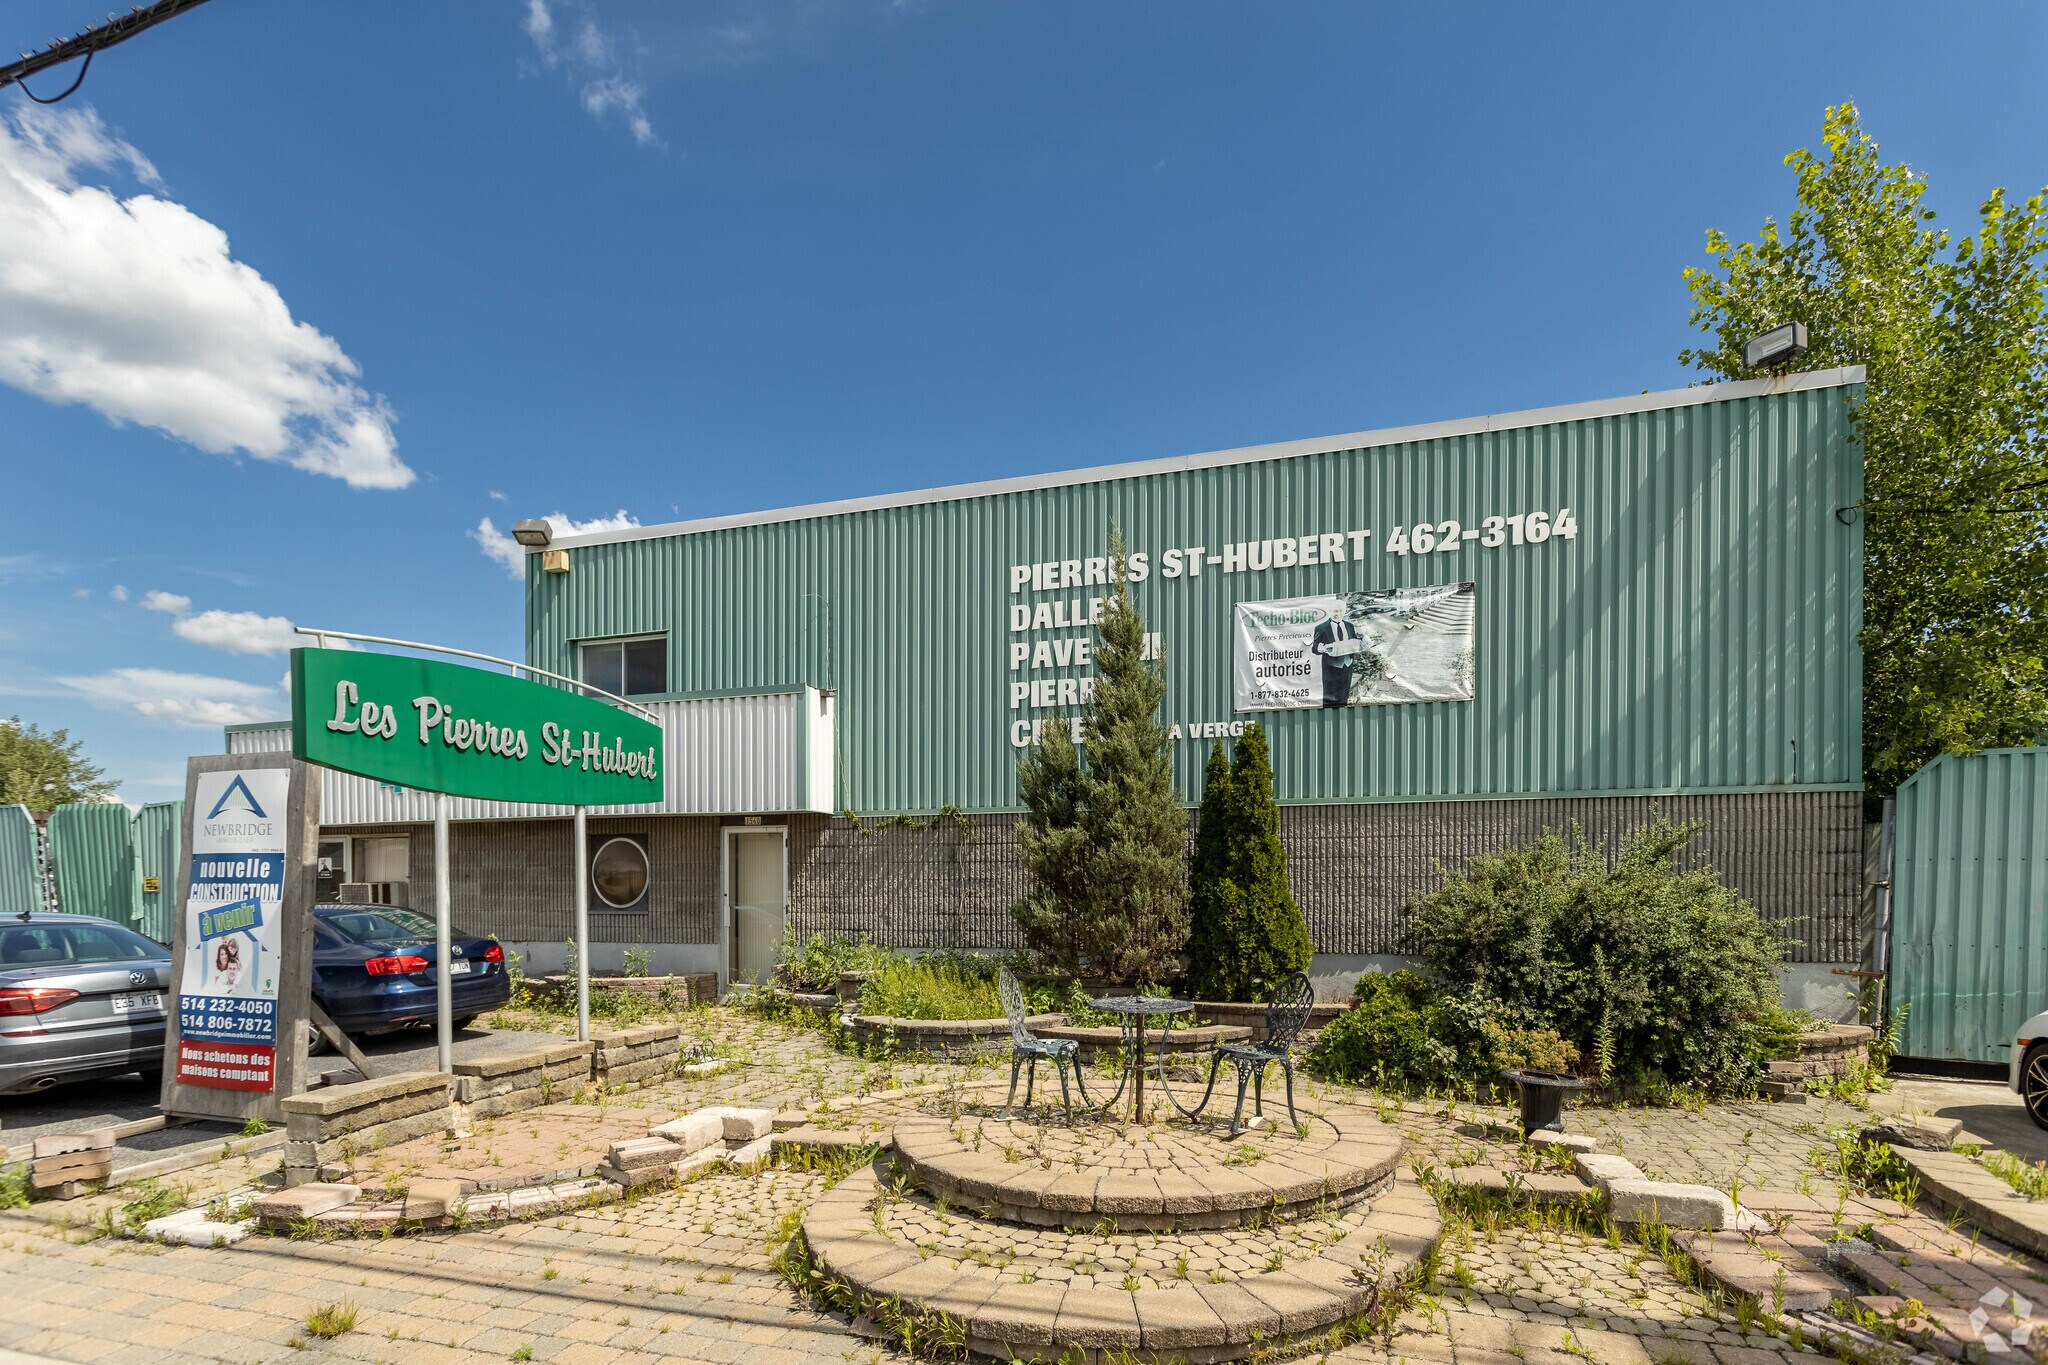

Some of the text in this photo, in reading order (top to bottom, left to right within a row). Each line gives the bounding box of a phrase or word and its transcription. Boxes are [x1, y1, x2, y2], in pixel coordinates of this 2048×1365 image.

[1162, 529, 1371, 578] ST-HUBERT
[1386, 508, 1578, 556] 462-3164
[1249, 609, 1319, 627] Techo-Bloc
[1254, 633, 1277, 642] Pierres
[1248, 650, 1304, 662] Distributeur
[1255, 660, 1311, 678] autorisé
[1010, 676, 1108, 709] PIERR
[1250, 688, 1310, 700] 1-877-832-4625
[327, 679, 658, 781] Les Pierres St-Hubert
[203, 822, 273, 837] NEWBRIDGE
[200, 858, 271, 879] nouvelle
[190, 882, 279, 904] CONSTRUCTION
[202, 902, 256, 937] à venir
[181, 997, 273, 1015] 514 232-4050
[181, 1014, 272, 1032] 514 806-7872
[181, 1047, 271, 1067] Nous achetons des
[181, 1064, 270, 1083] maisons comptant
